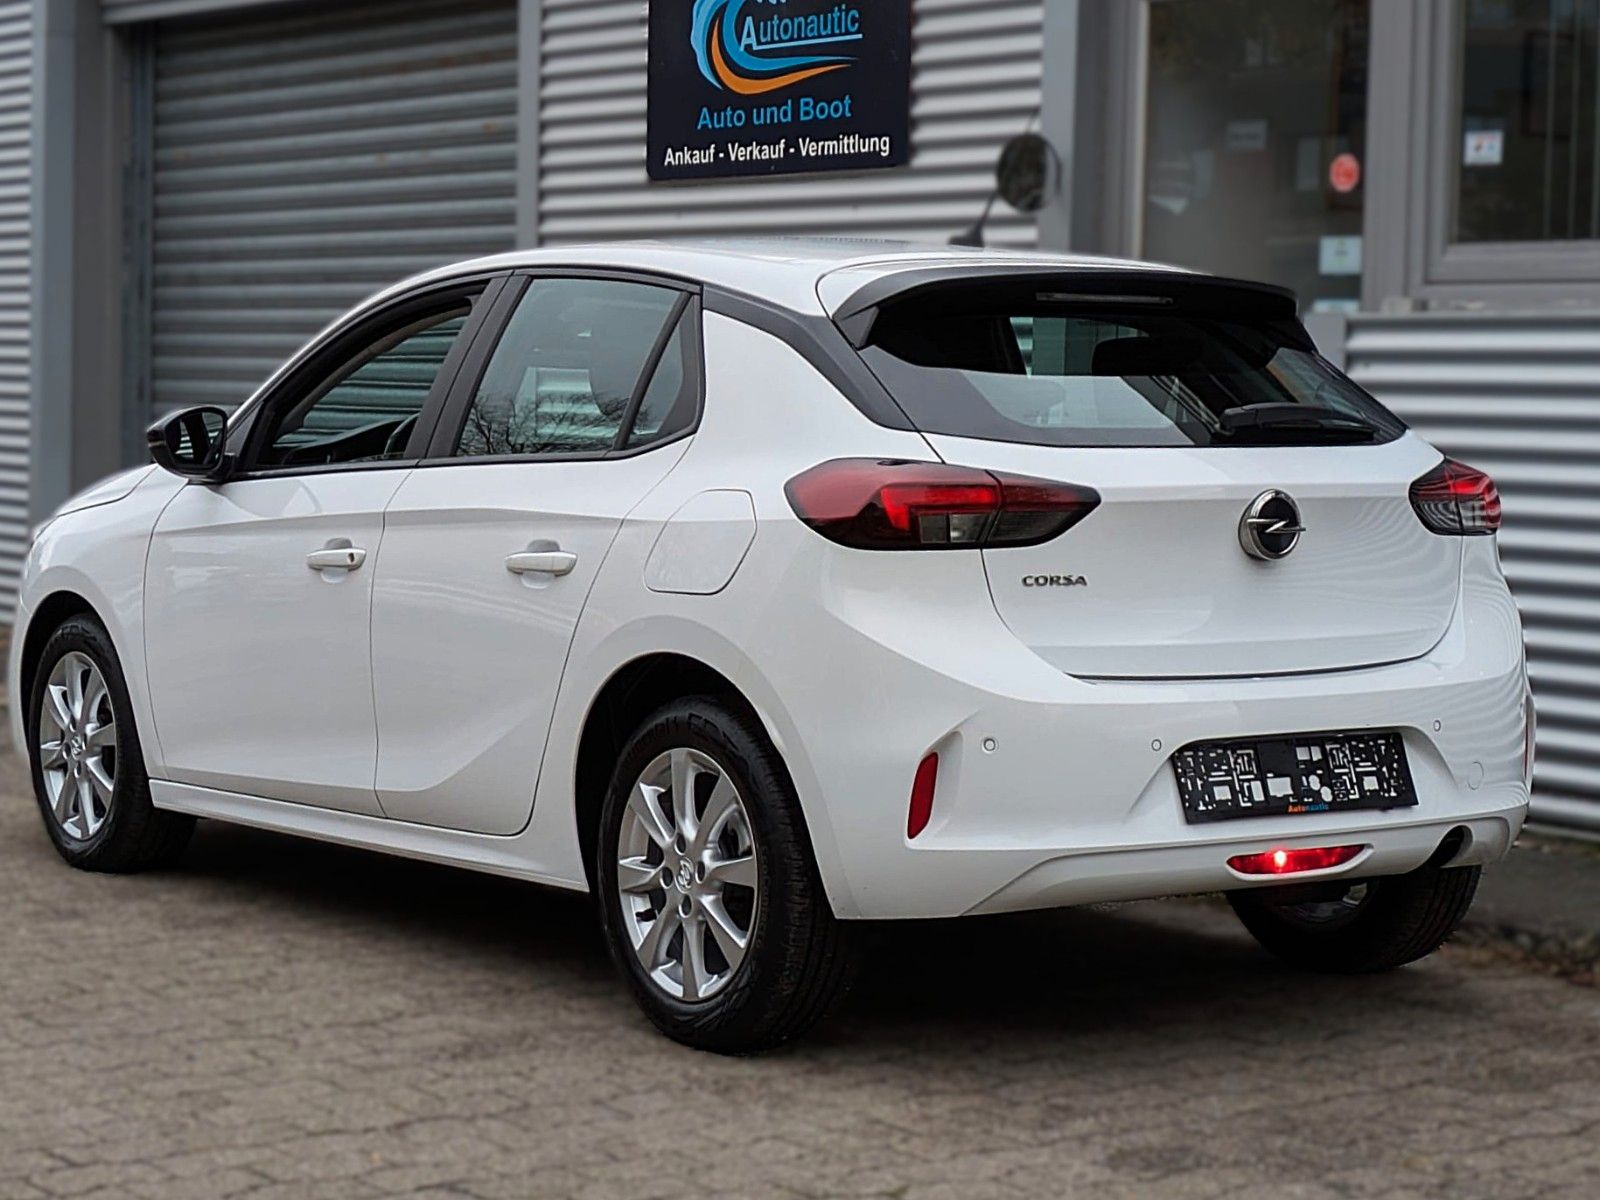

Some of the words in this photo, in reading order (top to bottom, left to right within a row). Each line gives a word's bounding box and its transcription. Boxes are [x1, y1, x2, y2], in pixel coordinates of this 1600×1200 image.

[739, 4, 860, 51] Autonautic
[697, 106, 746, 130] Auto
[752, 99, 792, 125] und
[799, 94, 852, 121] Boot
[664, 144, 716, 167] Ankauf
[727, 139, 786, 162] Verkauf
[798, 133, 890, 157] Vermittlung
[1022, 573, 1087, 587] CORSA
